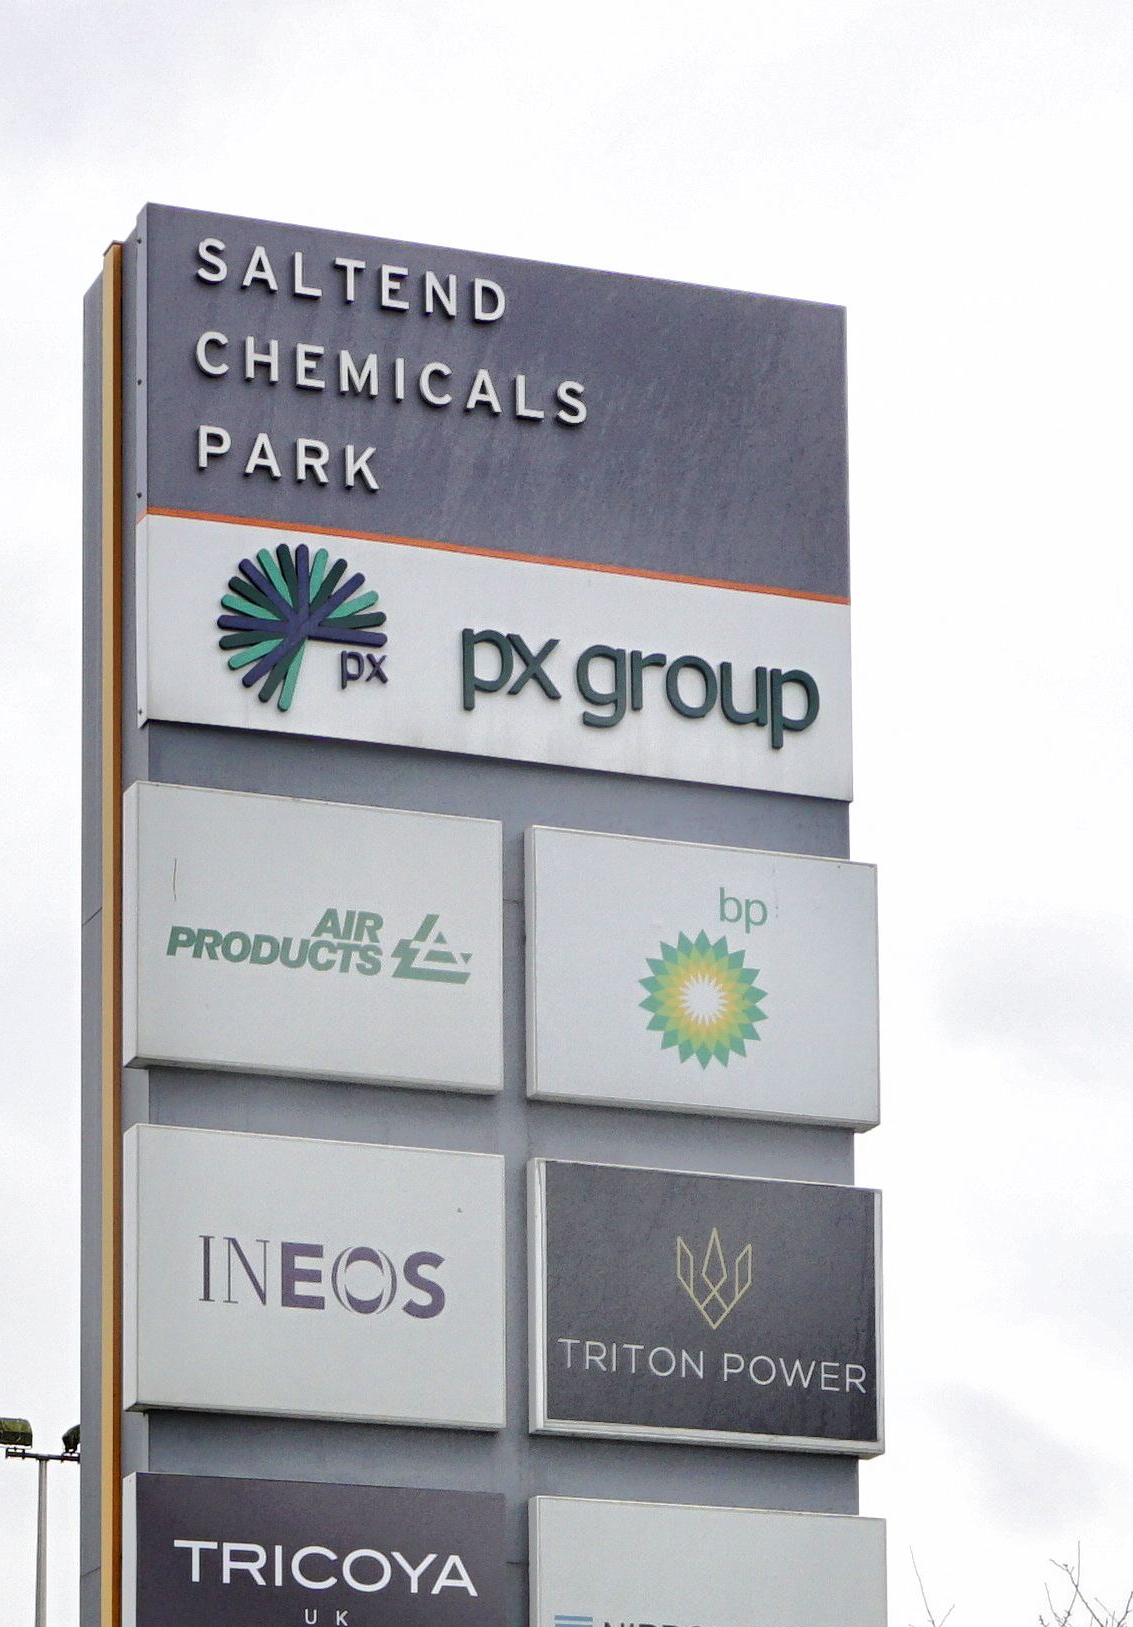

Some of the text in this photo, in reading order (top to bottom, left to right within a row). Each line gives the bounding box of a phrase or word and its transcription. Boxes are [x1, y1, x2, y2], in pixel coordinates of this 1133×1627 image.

[195, 237, 508, 323] SALTEND
[195, 331, 589, 427] CHEMICALS
[197, 425, 380, 492] PARK
[340, 648, 389, 690] px
[461, 626, 820, 750] px group
[312, 908, 384, 943] AIR
[718, 887, 768, 934] bp
[166, 926, 383, 976] PRODUCTS
[198, 1234, 446, 1319] INEOS
[557, 1337, 868, 1395] TRITON POWER
[173, 1539, 479, 1597] TRICOYA
